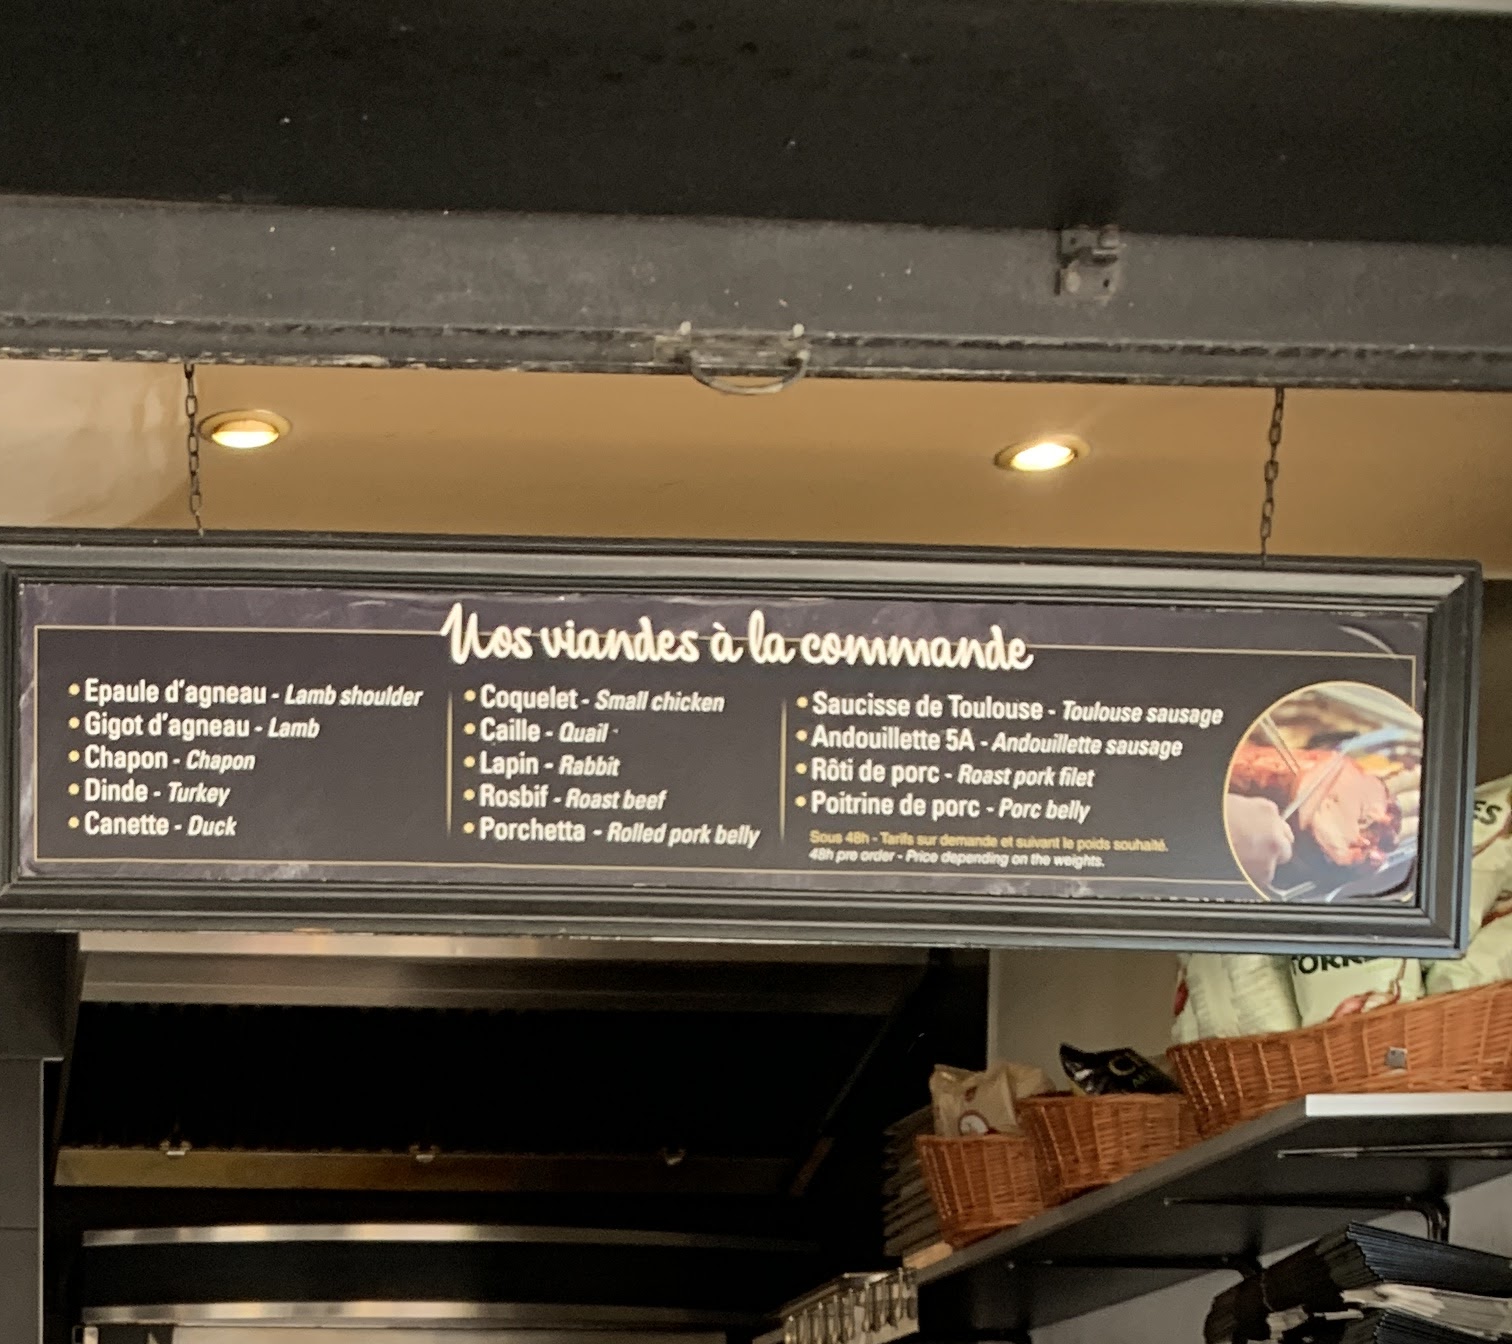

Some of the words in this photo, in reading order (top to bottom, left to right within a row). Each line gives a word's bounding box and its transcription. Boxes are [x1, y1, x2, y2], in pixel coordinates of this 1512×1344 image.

[441, 602, 532, 664] Nos
[541, 616, 699, 662] viandes
[711, 621, 742, 664] à
[749, 609, 795, 664] la
[801, 625, 1034, 670] commande
[84, 677, 160, 707] Epaule
[164, 679, 267, 709] d'agneau
[284, 683, 337, 706] Lamb
[339, 684, 424, 707] shoulder
[480, 683, 579, 714] Coquelet
[594, 688, 650, 711] Small
[650, 690, 725, 713] chicken
[812, 690, 911, 717] Saucisse
[915, 693, 943, 718] de
[947, 694, 1044, 721] Toulouse
[1062, 699, 1143, 723] Toulouse
[1145, 707, 1224, 729] sausage
[84, 710, 144, 741] Gigot
[147, 712, 250, 742] d'agneau
[267, 716, 320, 739] Lamb
[480, 716, 541, 743] Caille
[558, 721, 610, 743] Quail
[810, 724, 941, 751] Andouillette
[945, 727, 976, 752] 5A
[990, 731, 1103, 755] Andouillette
[1105, 738, 1183, 761] sausage
[84, 744, 168, 774] Chapon
[185, 749, 256, 774] Chapon
[480, 750, 539, 780] Lapin
[558, 754, 621, 777] Rabbit
[811, 756, 854, 782] Rôti
[858, 758, 886, 783] de
[891, 764, 940, 788] porc
[957, 763, 1013, 786] Roast
[1012, 765, 1056, 790] pork
[1058, 766, 1096, 788] filet
[84, 777, 149, 803] Dinde
[168, 781, 231, 808] Turkey
[479, 783, 549, 809] Rosbif
[564, 787, 621, 810] Roast
[622, 789, 668, 811] beef
[811, 789, 894, 816] Poitrine
[899, 792, 927, 817] de
[931, 798, 980, 822] porc
[998, 797, 1042, 820] Porc
[1045, 799, 1091, 825] belly
[84, 810, 170, 836] Canette
[187, 814, 238, 837] Duck
[479, 816, 586, 842] Porchetta
[606, 821, 668, 844] Rolled
[667, 823, 712, 848] pork
[714, 824, 761, 850] belly
